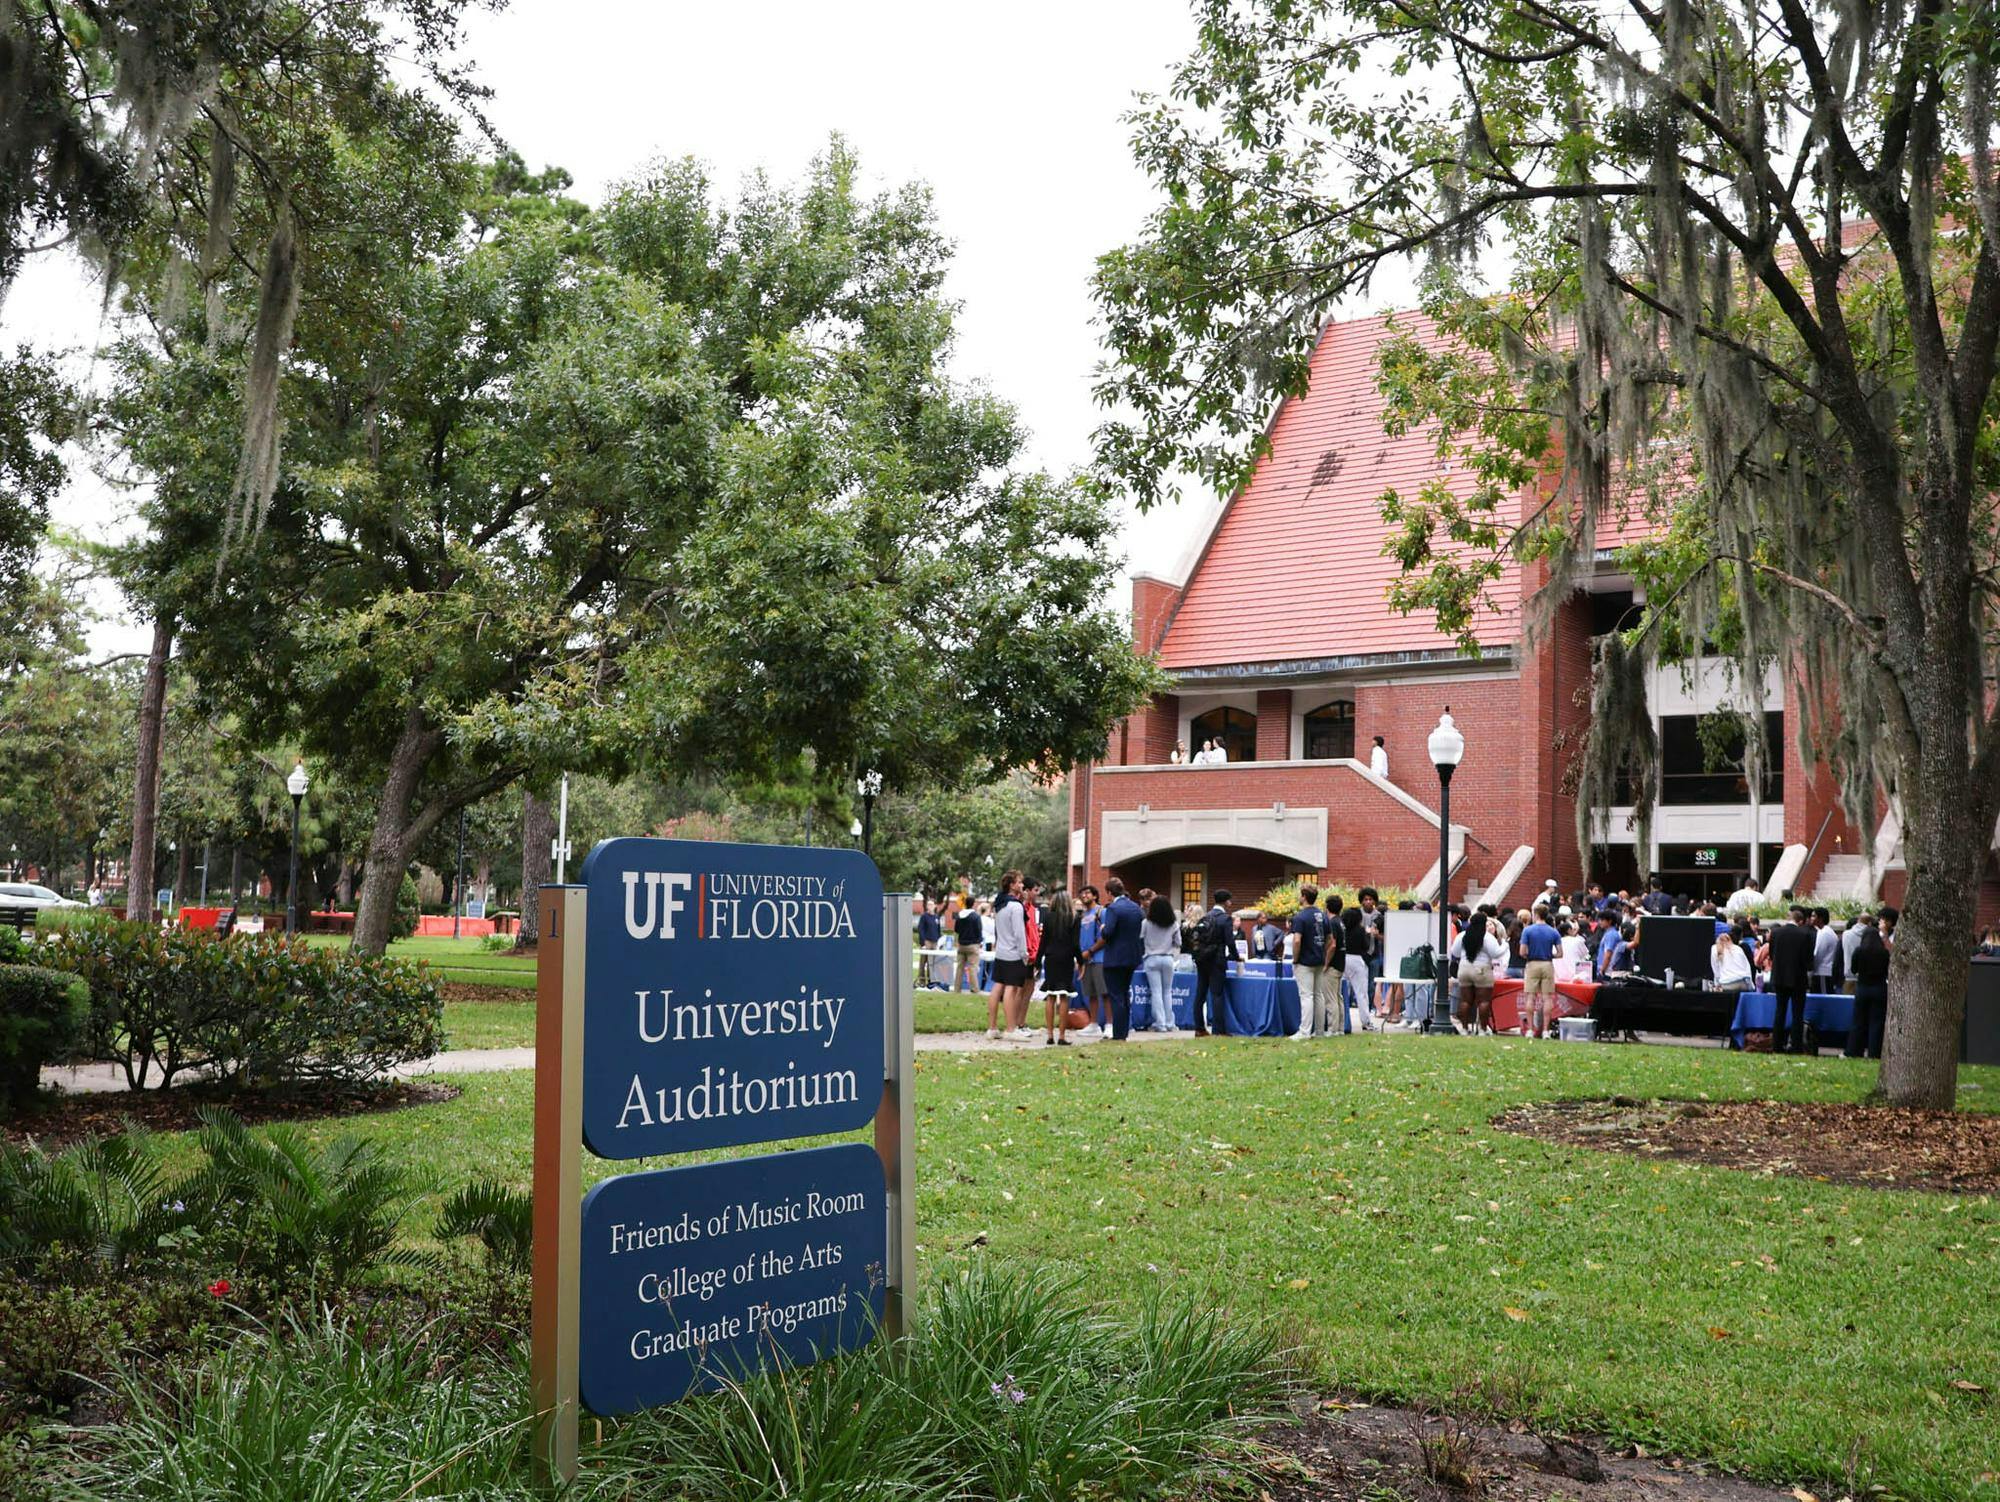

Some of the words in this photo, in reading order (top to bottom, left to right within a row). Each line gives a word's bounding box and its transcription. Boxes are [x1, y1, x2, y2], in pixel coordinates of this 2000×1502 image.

[710, 873, 826, 897] UNIVERSITY
[832, 878, 846, 900] of
[1695, 850, 1716, 861] 333
[622, 871, 692, 940] UF
[708, 898, 857, 940] FLORIDA
[634, 984, 846, 1048] University
[615, 1060, 859, 1129] Auditorium
[610, 1212, 701, 1255] Friends
[707, 1205, 731, 1237] of
[735, 1197, 801, 1232] Music
[806, 1192, 865, 1220] Room
[638, 1266, 727, 1302] College
[732, 1252, 756, 1285] of
[760, 1250, 794, 1279] the
[798, 1242, 843, 1271] Arts
[630, 1315, 741, 1360] Graduate
[747, 1293, 847, 1334] Programs
